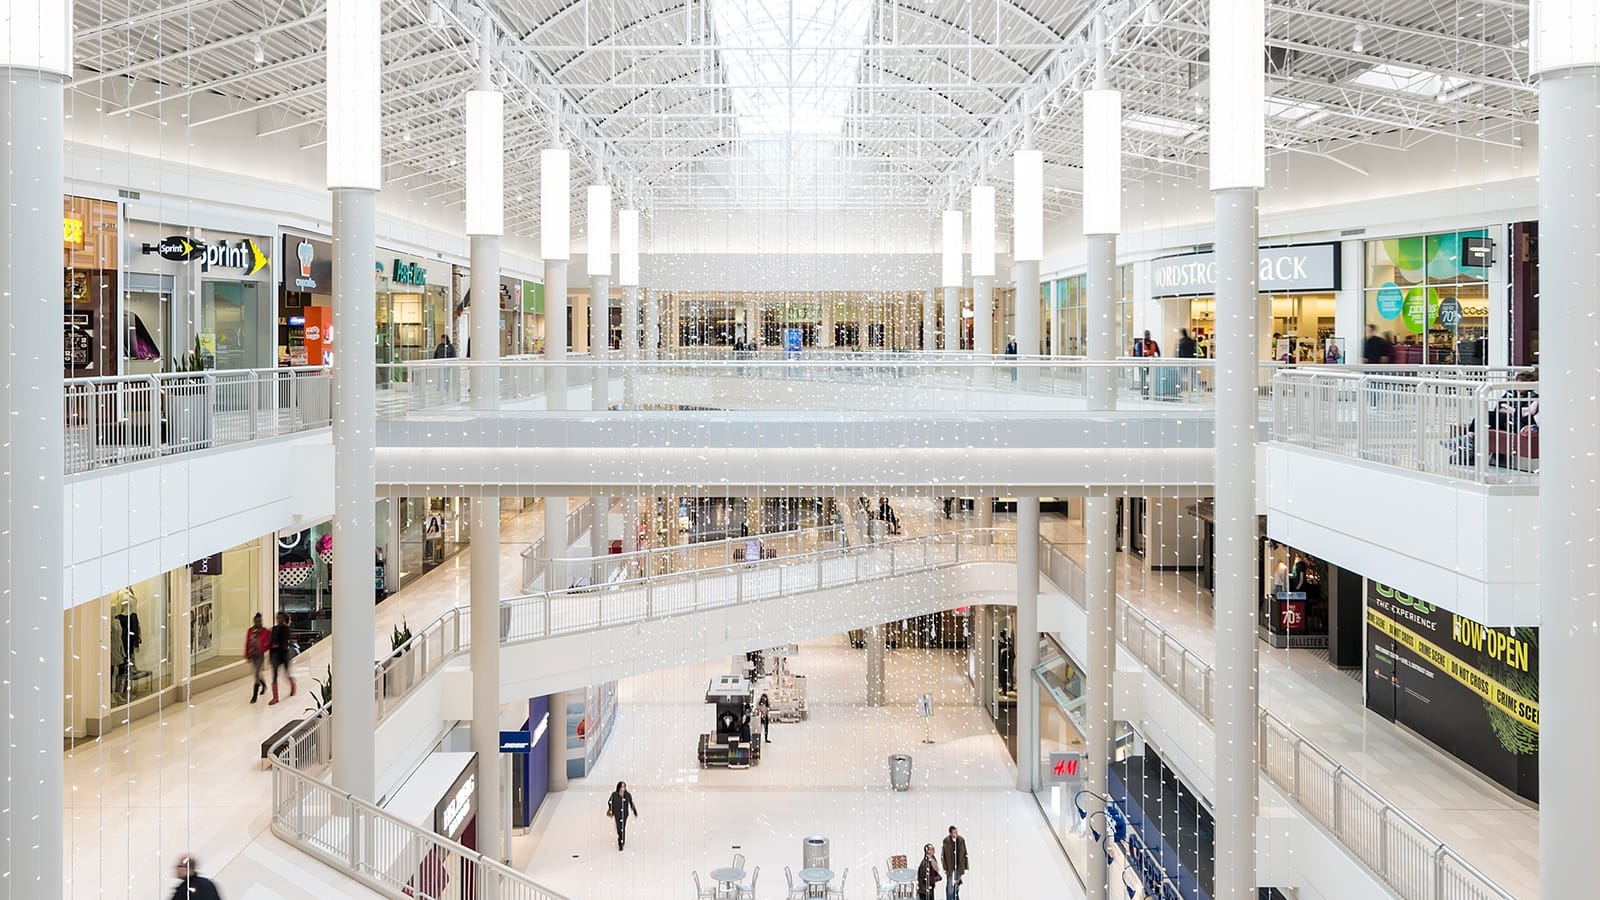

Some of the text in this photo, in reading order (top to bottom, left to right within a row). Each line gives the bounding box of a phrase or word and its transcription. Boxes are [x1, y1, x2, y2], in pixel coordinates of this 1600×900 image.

[161, 244, 183, 254] Sprint
[1376, 598, 1390, 611] THE
[1391, 605, 1436, 631] EXPERIENCE
[1487, 629, 1528, 672] OPEN
[1452, 662, 1457, 675] DO
[1459, 666, 1469, 683] NOT
[1470, 672, 1488, 695] CROSS
[1497, 689, 1517, 713] CRIME
